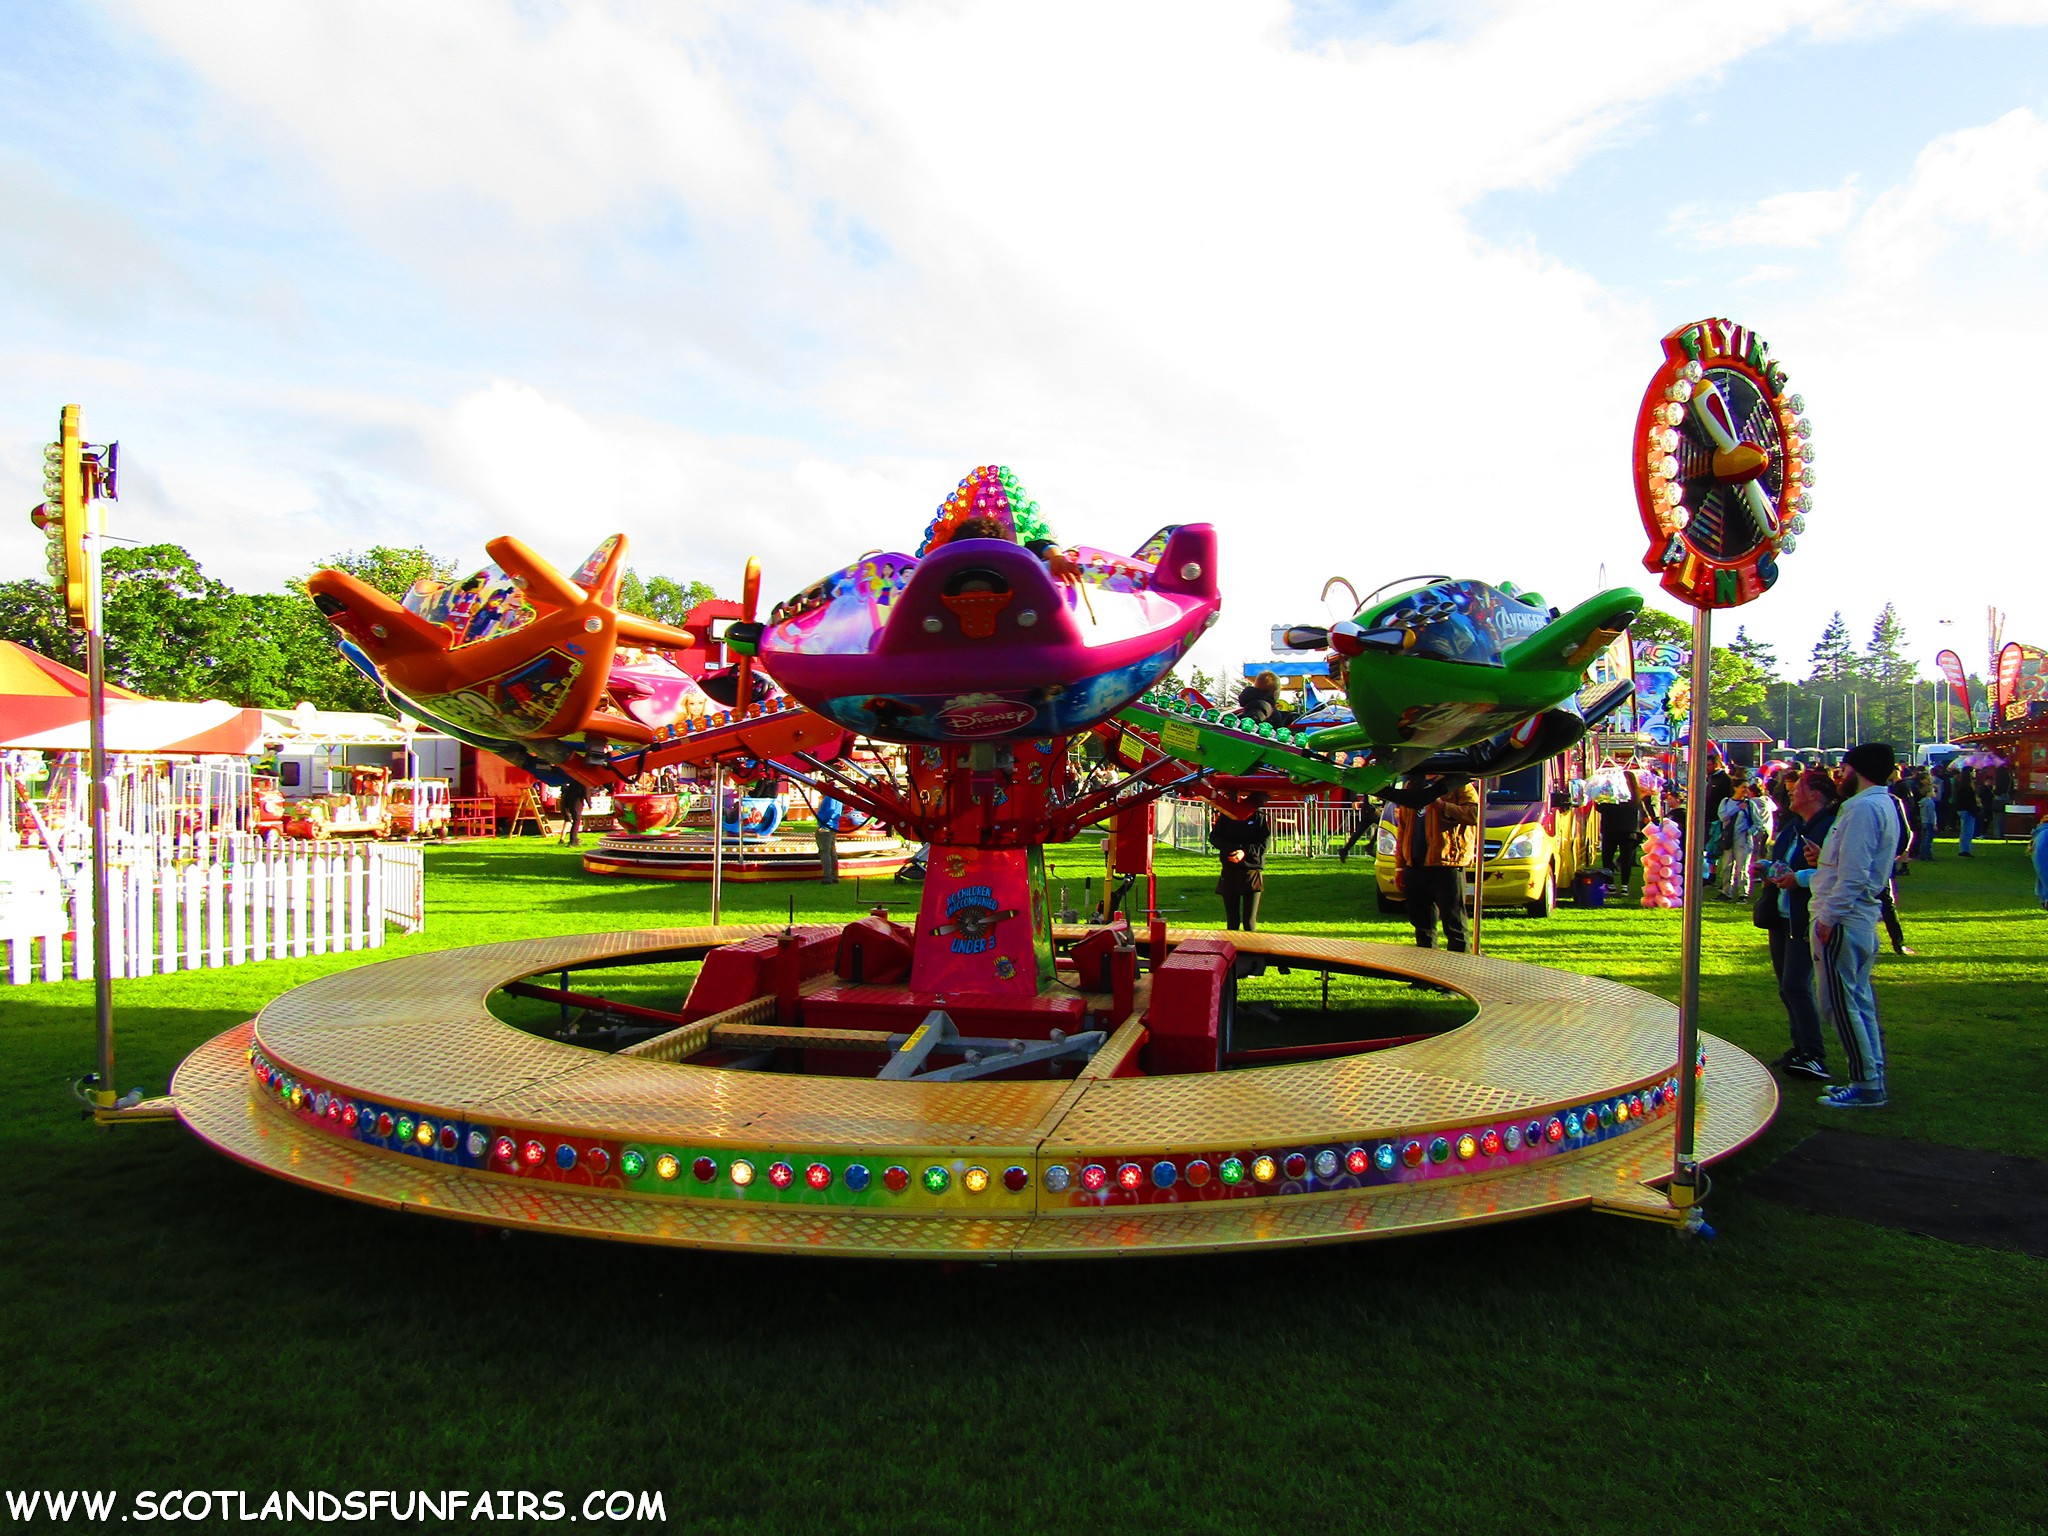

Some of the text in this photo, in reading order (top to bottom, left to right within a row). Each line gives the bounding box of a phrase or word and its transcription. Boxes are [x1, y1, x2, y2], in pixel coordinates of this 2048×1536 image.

[1679, 318, 1790, 397] FLYING
[1662, 531, 1779, 605] PLANES
[957, 885, 993, 899] CHILDREN
[951, 935, 996, 954] UNDER 3
